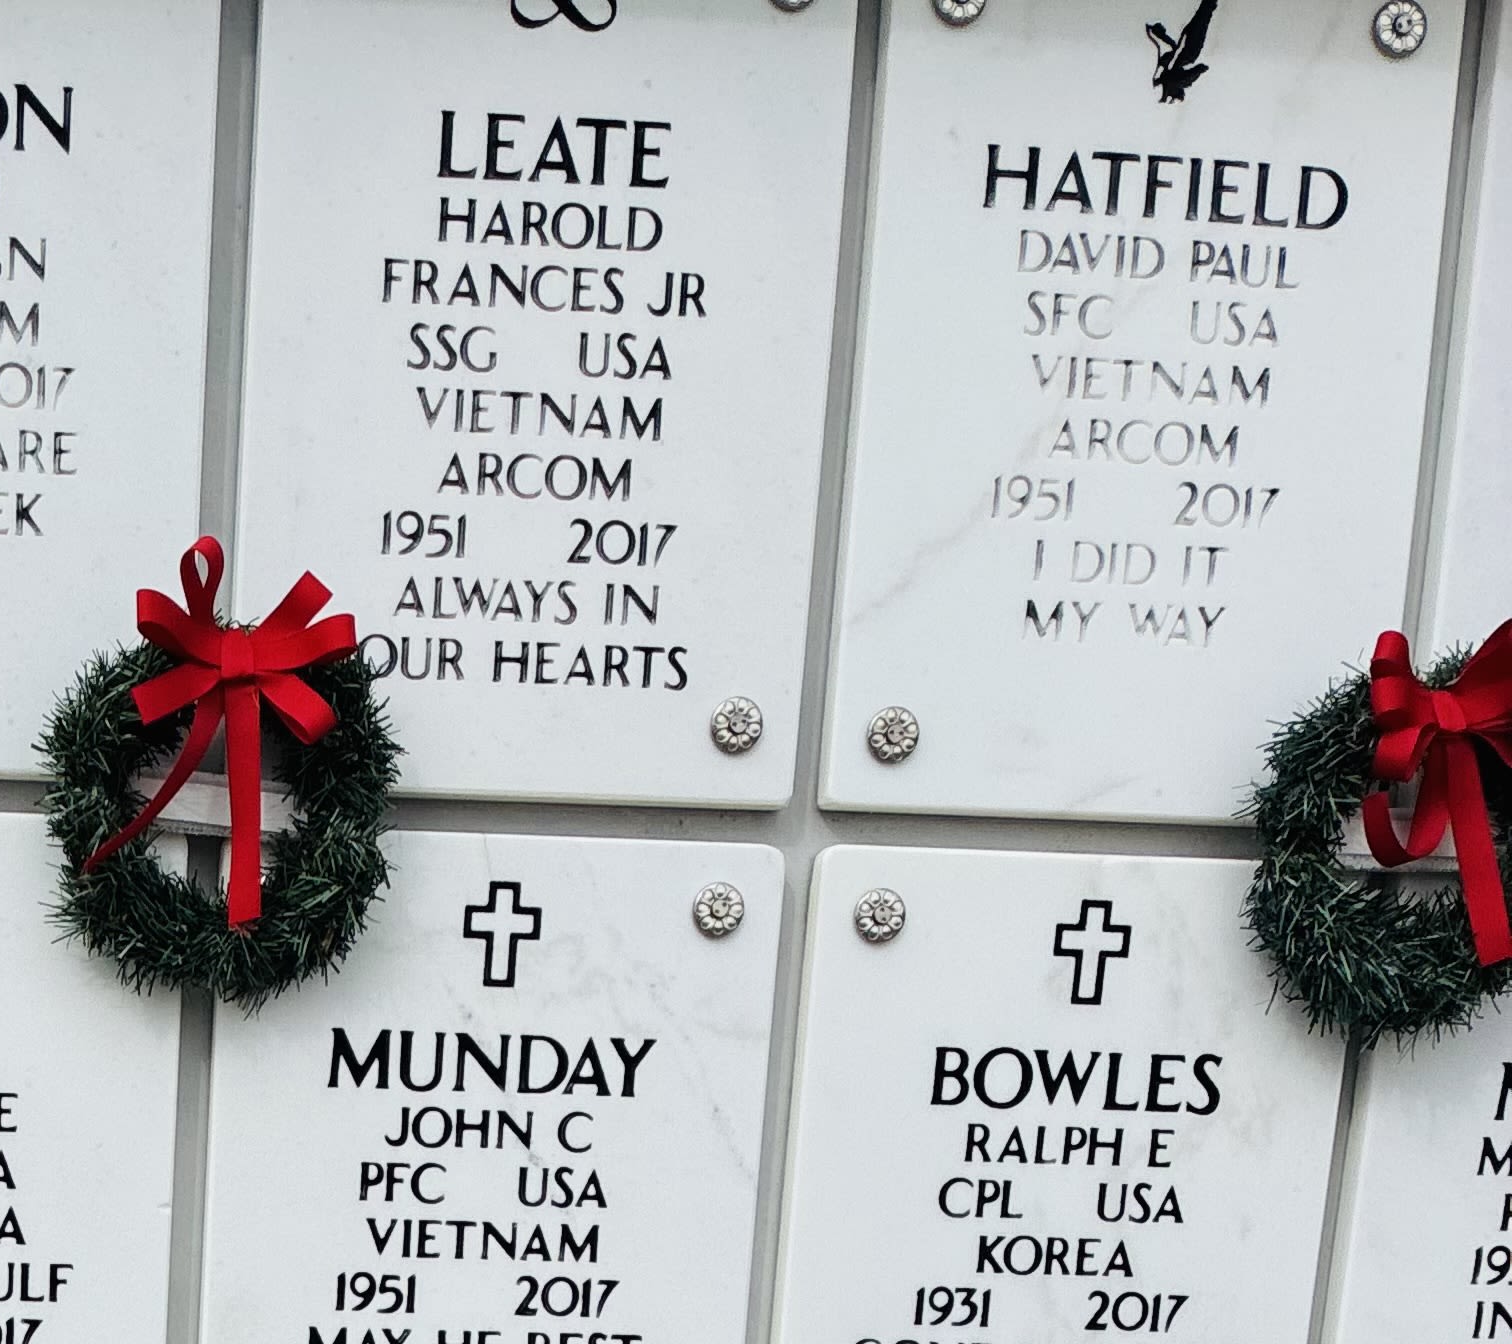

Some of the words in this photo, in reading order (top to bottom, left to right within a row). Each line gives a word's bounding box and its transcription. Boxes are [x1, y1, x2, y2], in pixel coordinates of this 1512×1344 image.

[436, 108, 673, 190] LEATE
[981, 142, 1350, 232] HATFIELD
[381, 256, 625, 316] FRANCES
[646, 270, 708, 319] JR
[1017, 228, 1166, 280] DAVID
[1188, 238, 1300, 290] PAUL
[406, 321, 498, 374] SSG
[577, 331, 673, 381] USA
[1030, 352, 1271, 409] VIETNAM
[436, 451, 633, 503] ARCOM
[990, 473, 1076, 521] 1951
[1172, 480, 1282, 529] 2017
[326, 1026, 658, 1099] MUNDAY
[929, 1045, 1224, 1117] BOWLES
[358, 1160, 448, 1206] PFC
[517, 1165, 608, 1210] USA
[365, 1216, 601, 1264] VIETNAM
[975, 1234, 1134, 1279] KOREA
